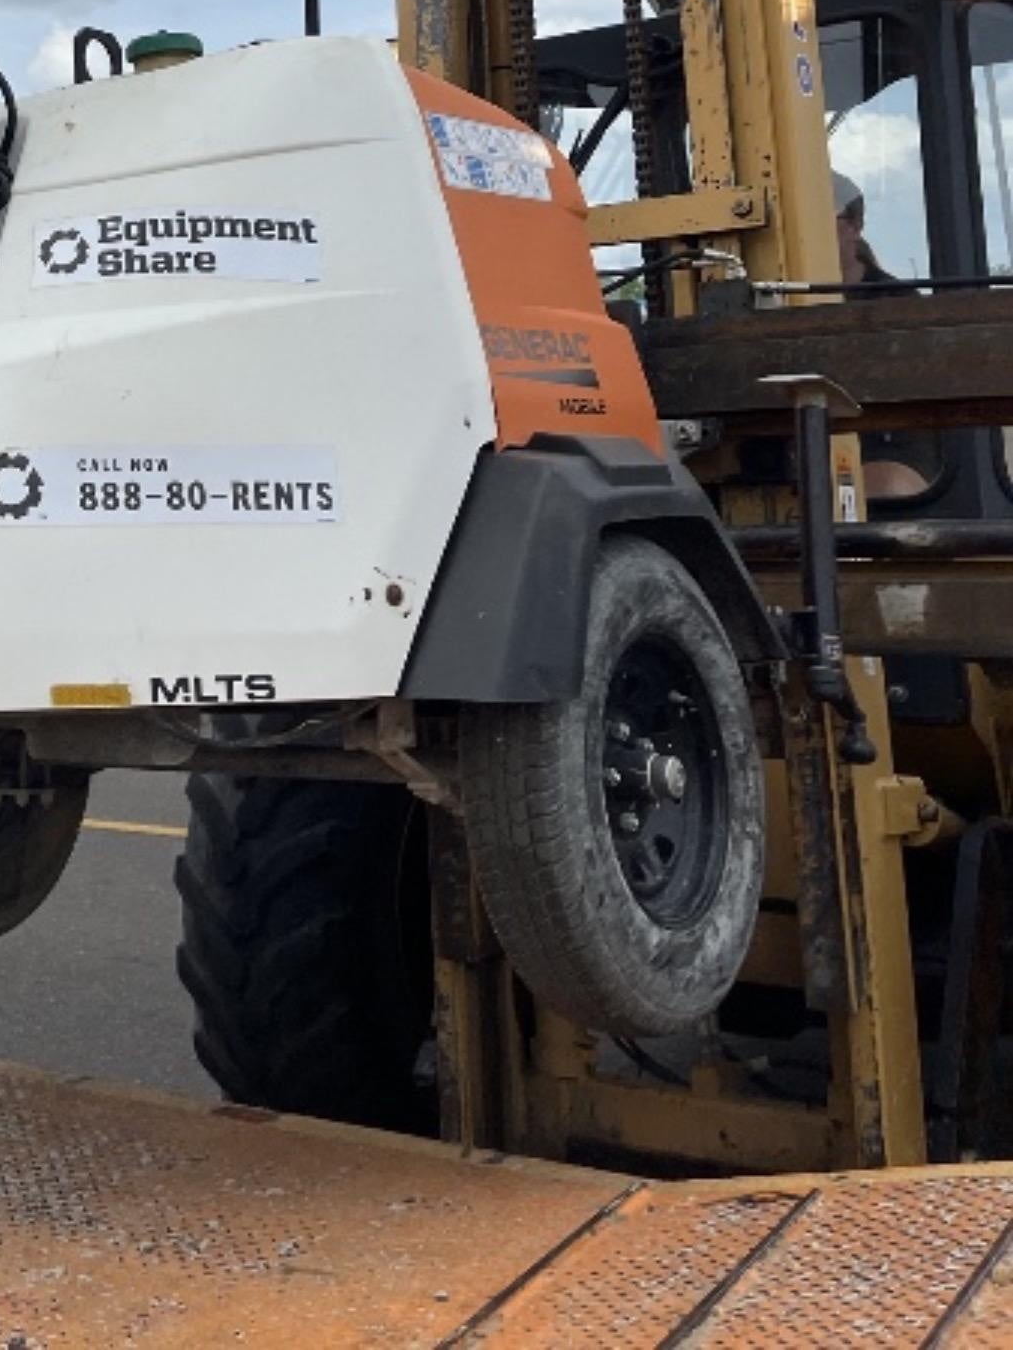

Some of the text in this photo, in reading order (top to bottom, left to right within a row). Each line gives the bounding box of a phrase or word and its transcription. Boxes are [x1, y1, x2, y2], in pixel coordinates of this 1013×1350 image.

[96, 211, 318, 245] Equipment
[96, 247, 217, 276] Share
[76, 457, 169, 472] CALL NOW
[78, 481, 334, 512] 888-80-RENTS
[149, 674, 277, 703] MLTS
